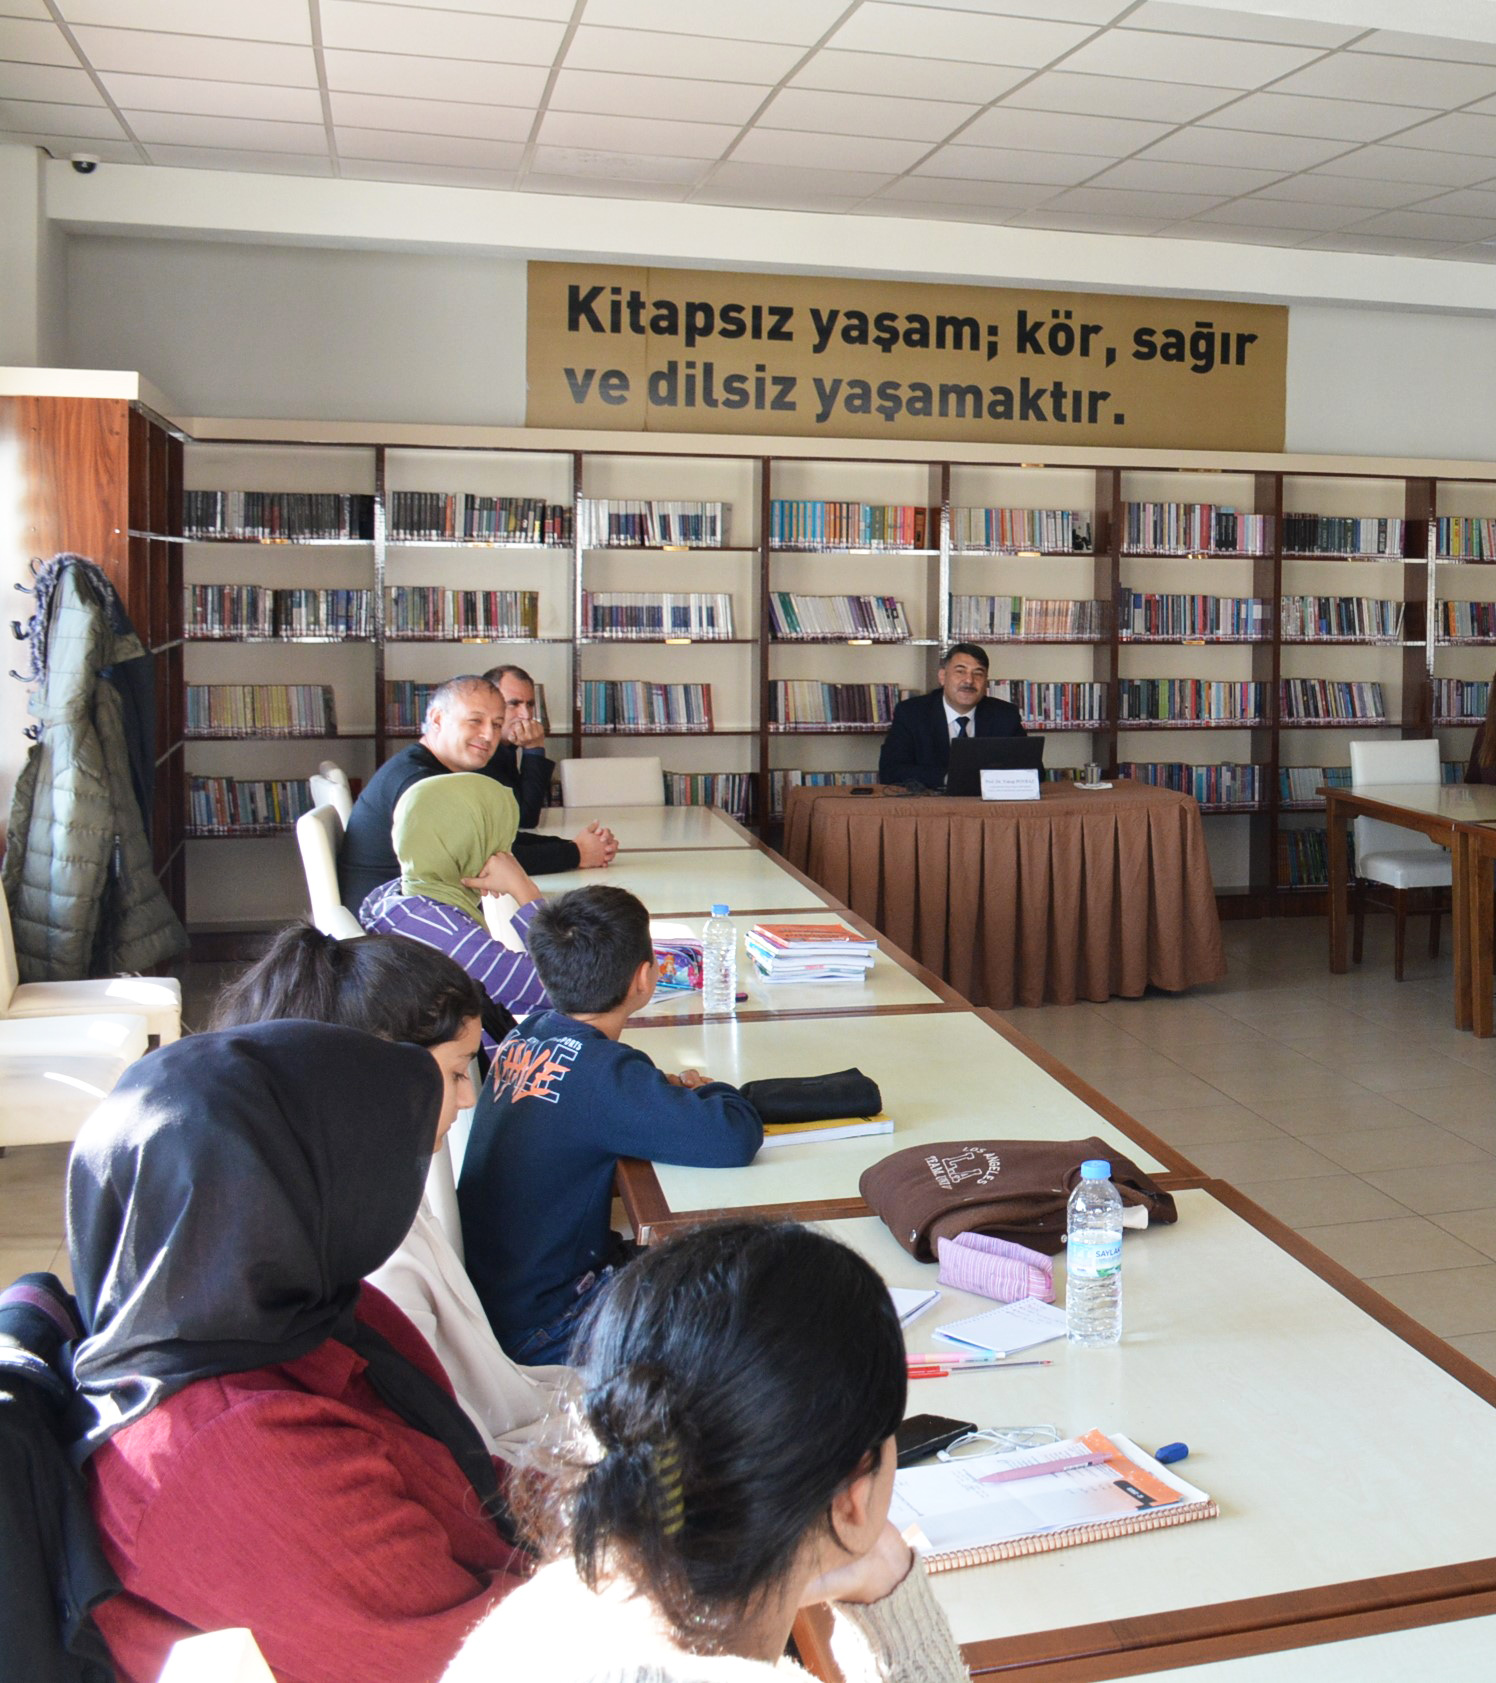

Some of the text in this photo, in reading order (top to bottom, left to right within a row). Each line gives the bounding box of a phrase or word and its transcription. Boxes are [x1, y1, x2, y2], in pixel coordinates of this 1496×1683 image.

[567, 284, 1259, 374] Kitapsız yaşam; kör, sağır
[563, 360, 1126, 425] ve dilsiz yaşamaktır.
[976, 1152, 1001, 1185] ANGELES
